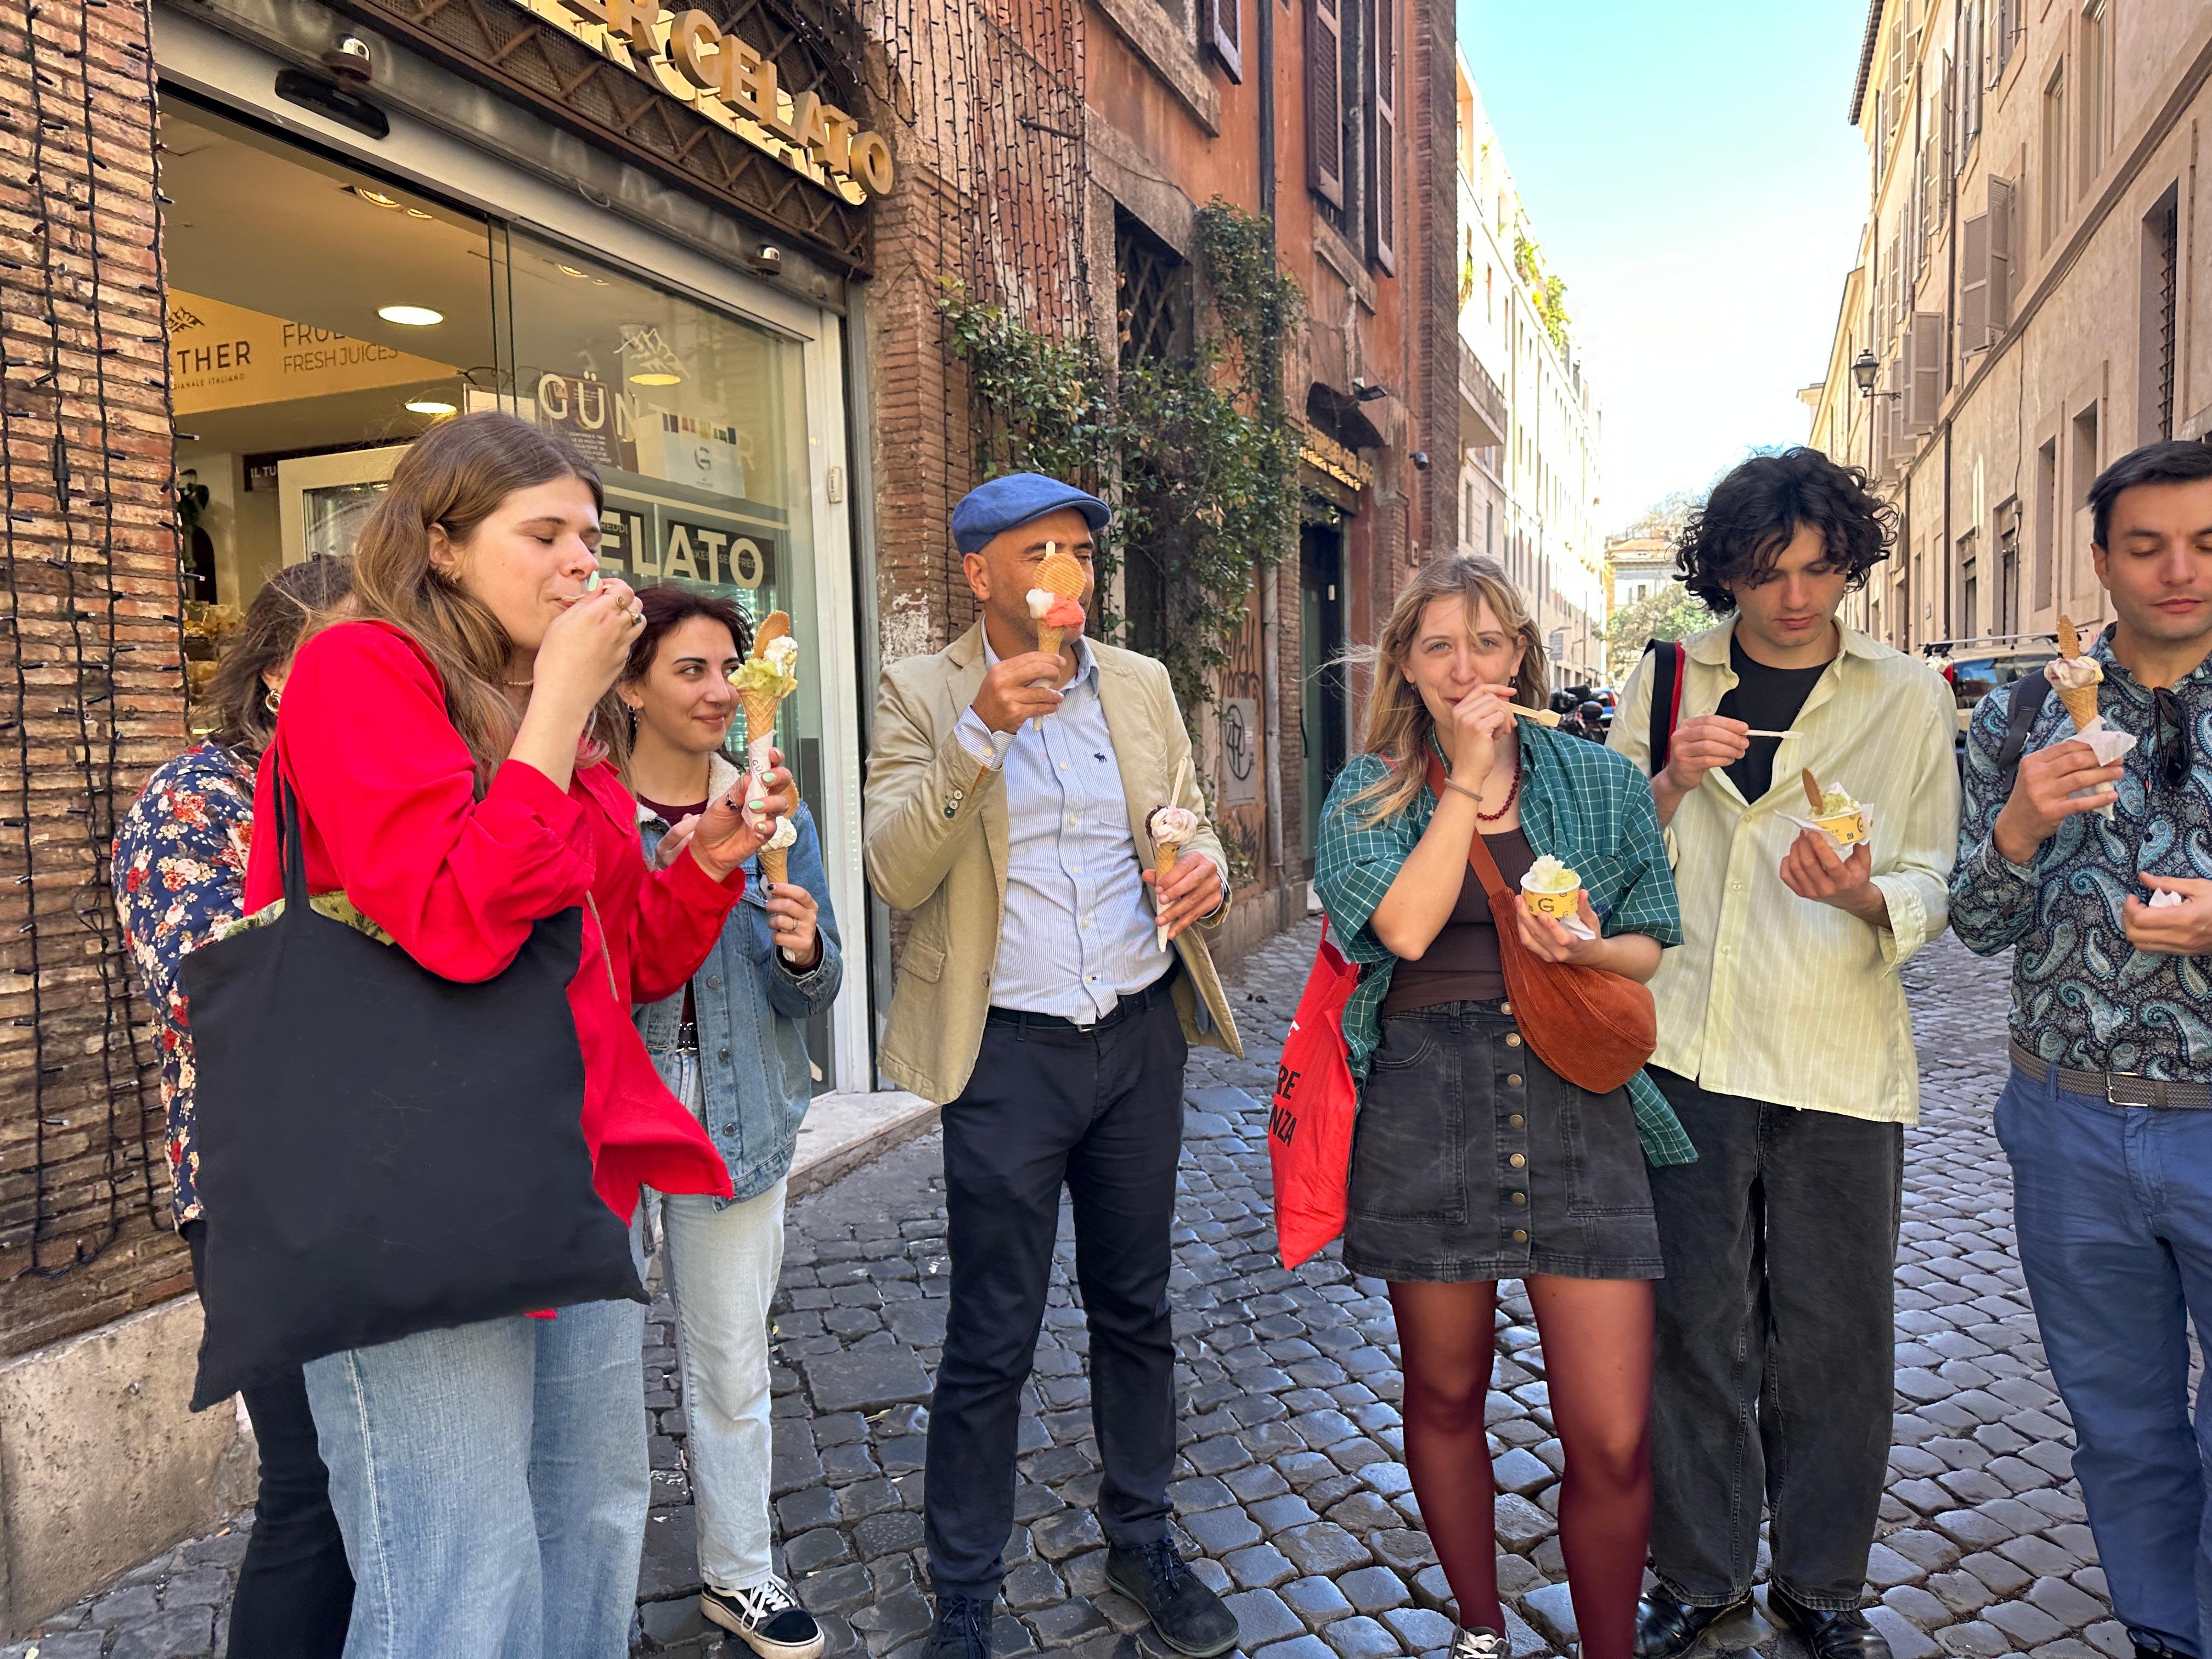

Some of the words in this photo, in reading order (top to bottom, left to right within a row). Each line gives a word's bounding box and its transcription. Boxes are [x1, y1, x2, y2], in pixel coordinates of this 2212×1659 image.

[171, 341, 251, 375] THER
[284, 349, 336, 373] FRESH
[1538, 898, 1554, 913] G
[1276, 1063, 1301, 1101] RE
[1268, 1103, 1297, 1148] NZA
